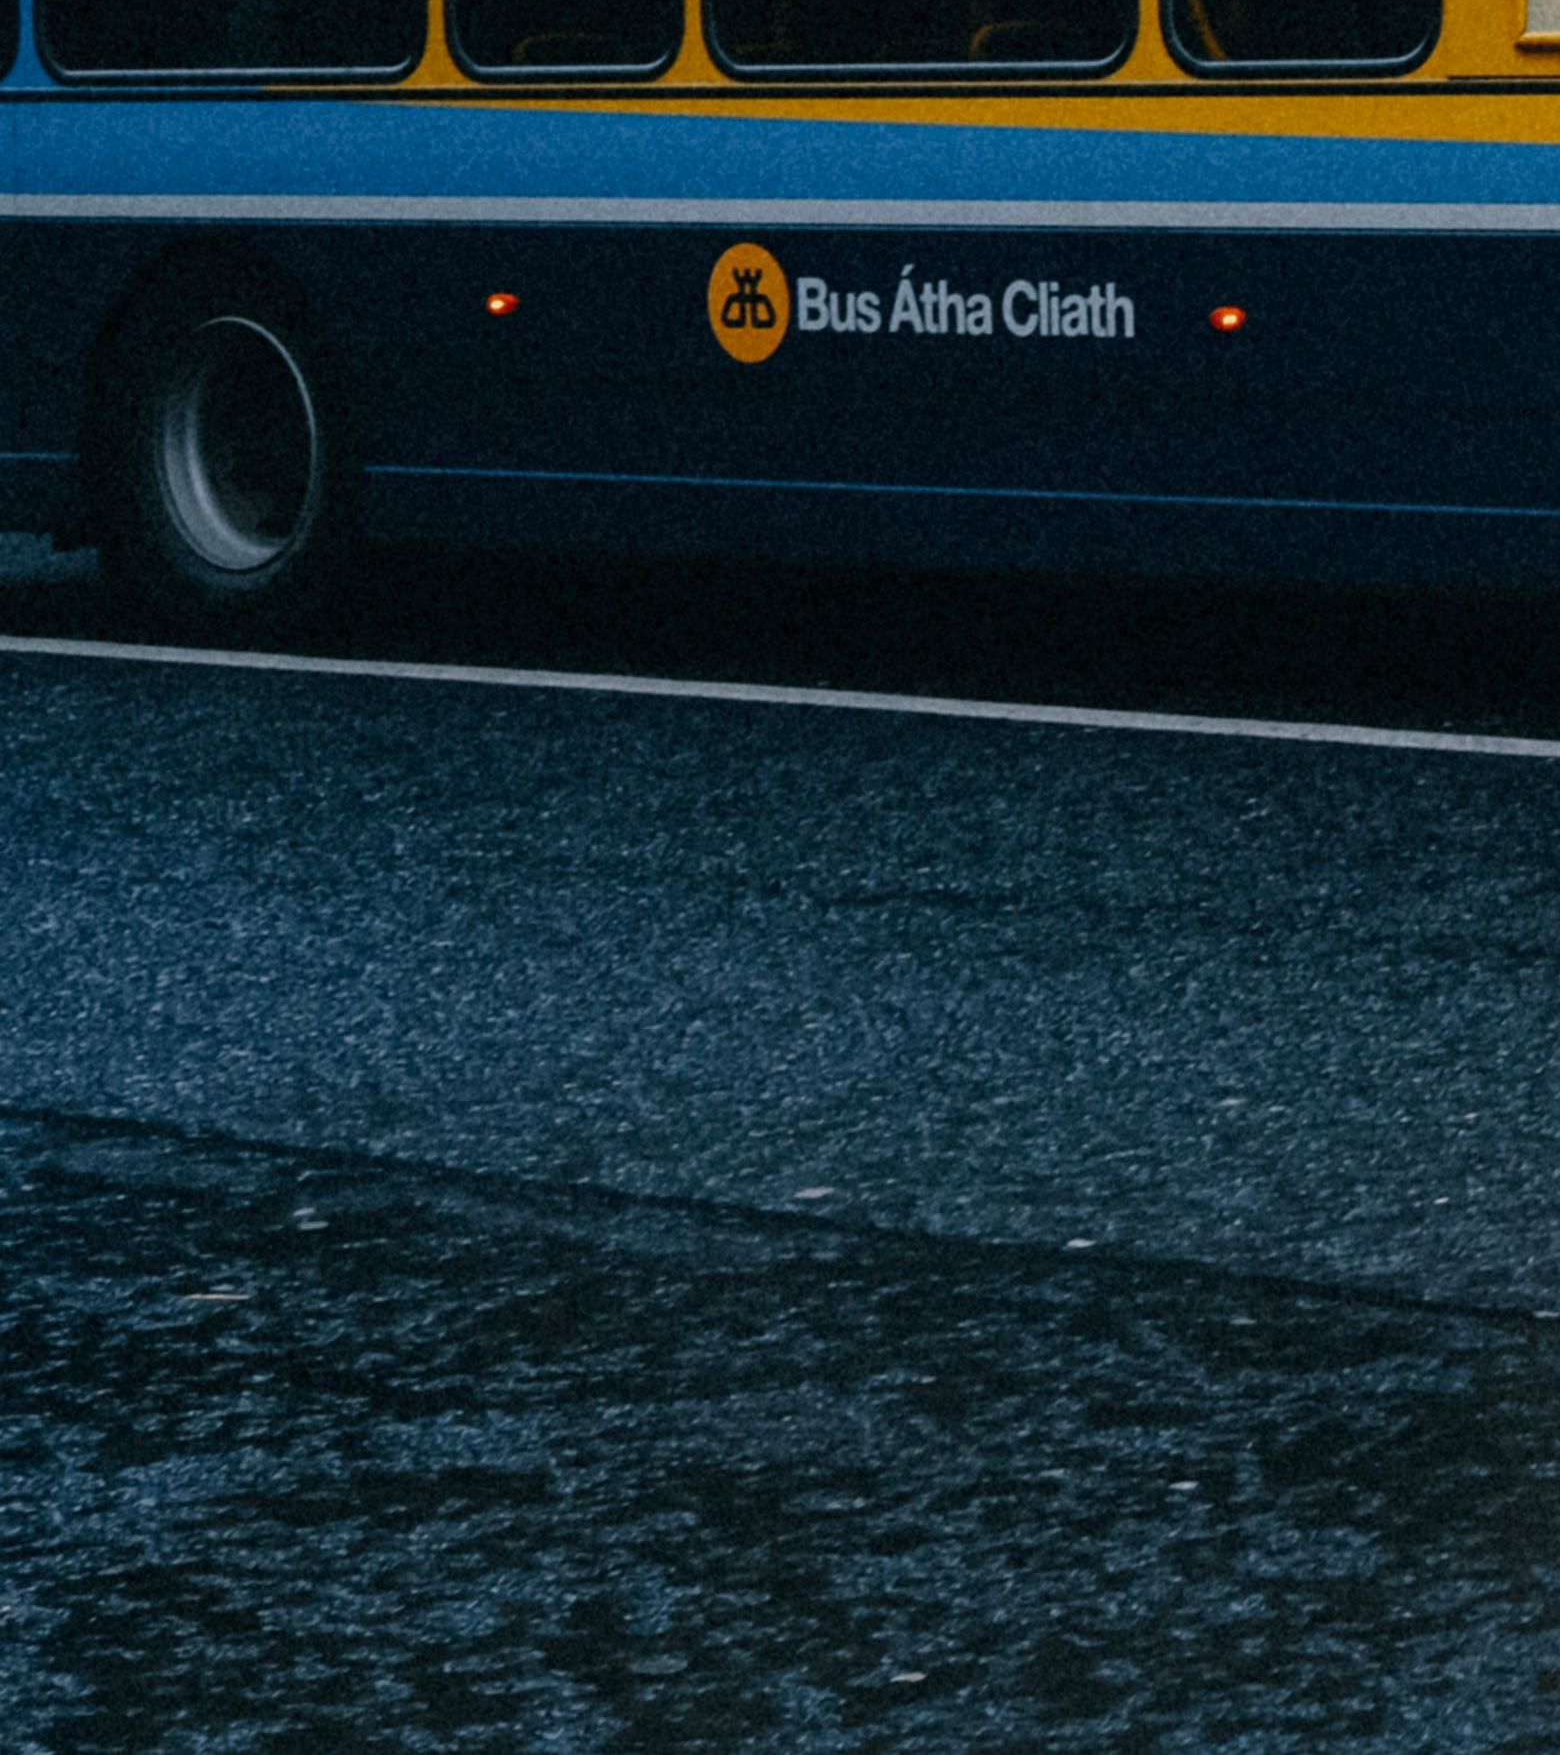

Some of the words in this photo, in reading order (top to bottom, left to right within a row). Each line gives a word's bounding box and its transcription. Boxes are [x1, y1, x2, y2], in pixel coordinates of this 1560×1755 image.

[798, 275, 882, 335] Bus
[889, 263, 993, 337] Átha
[1001, 279, 1135, 339] Cliath
